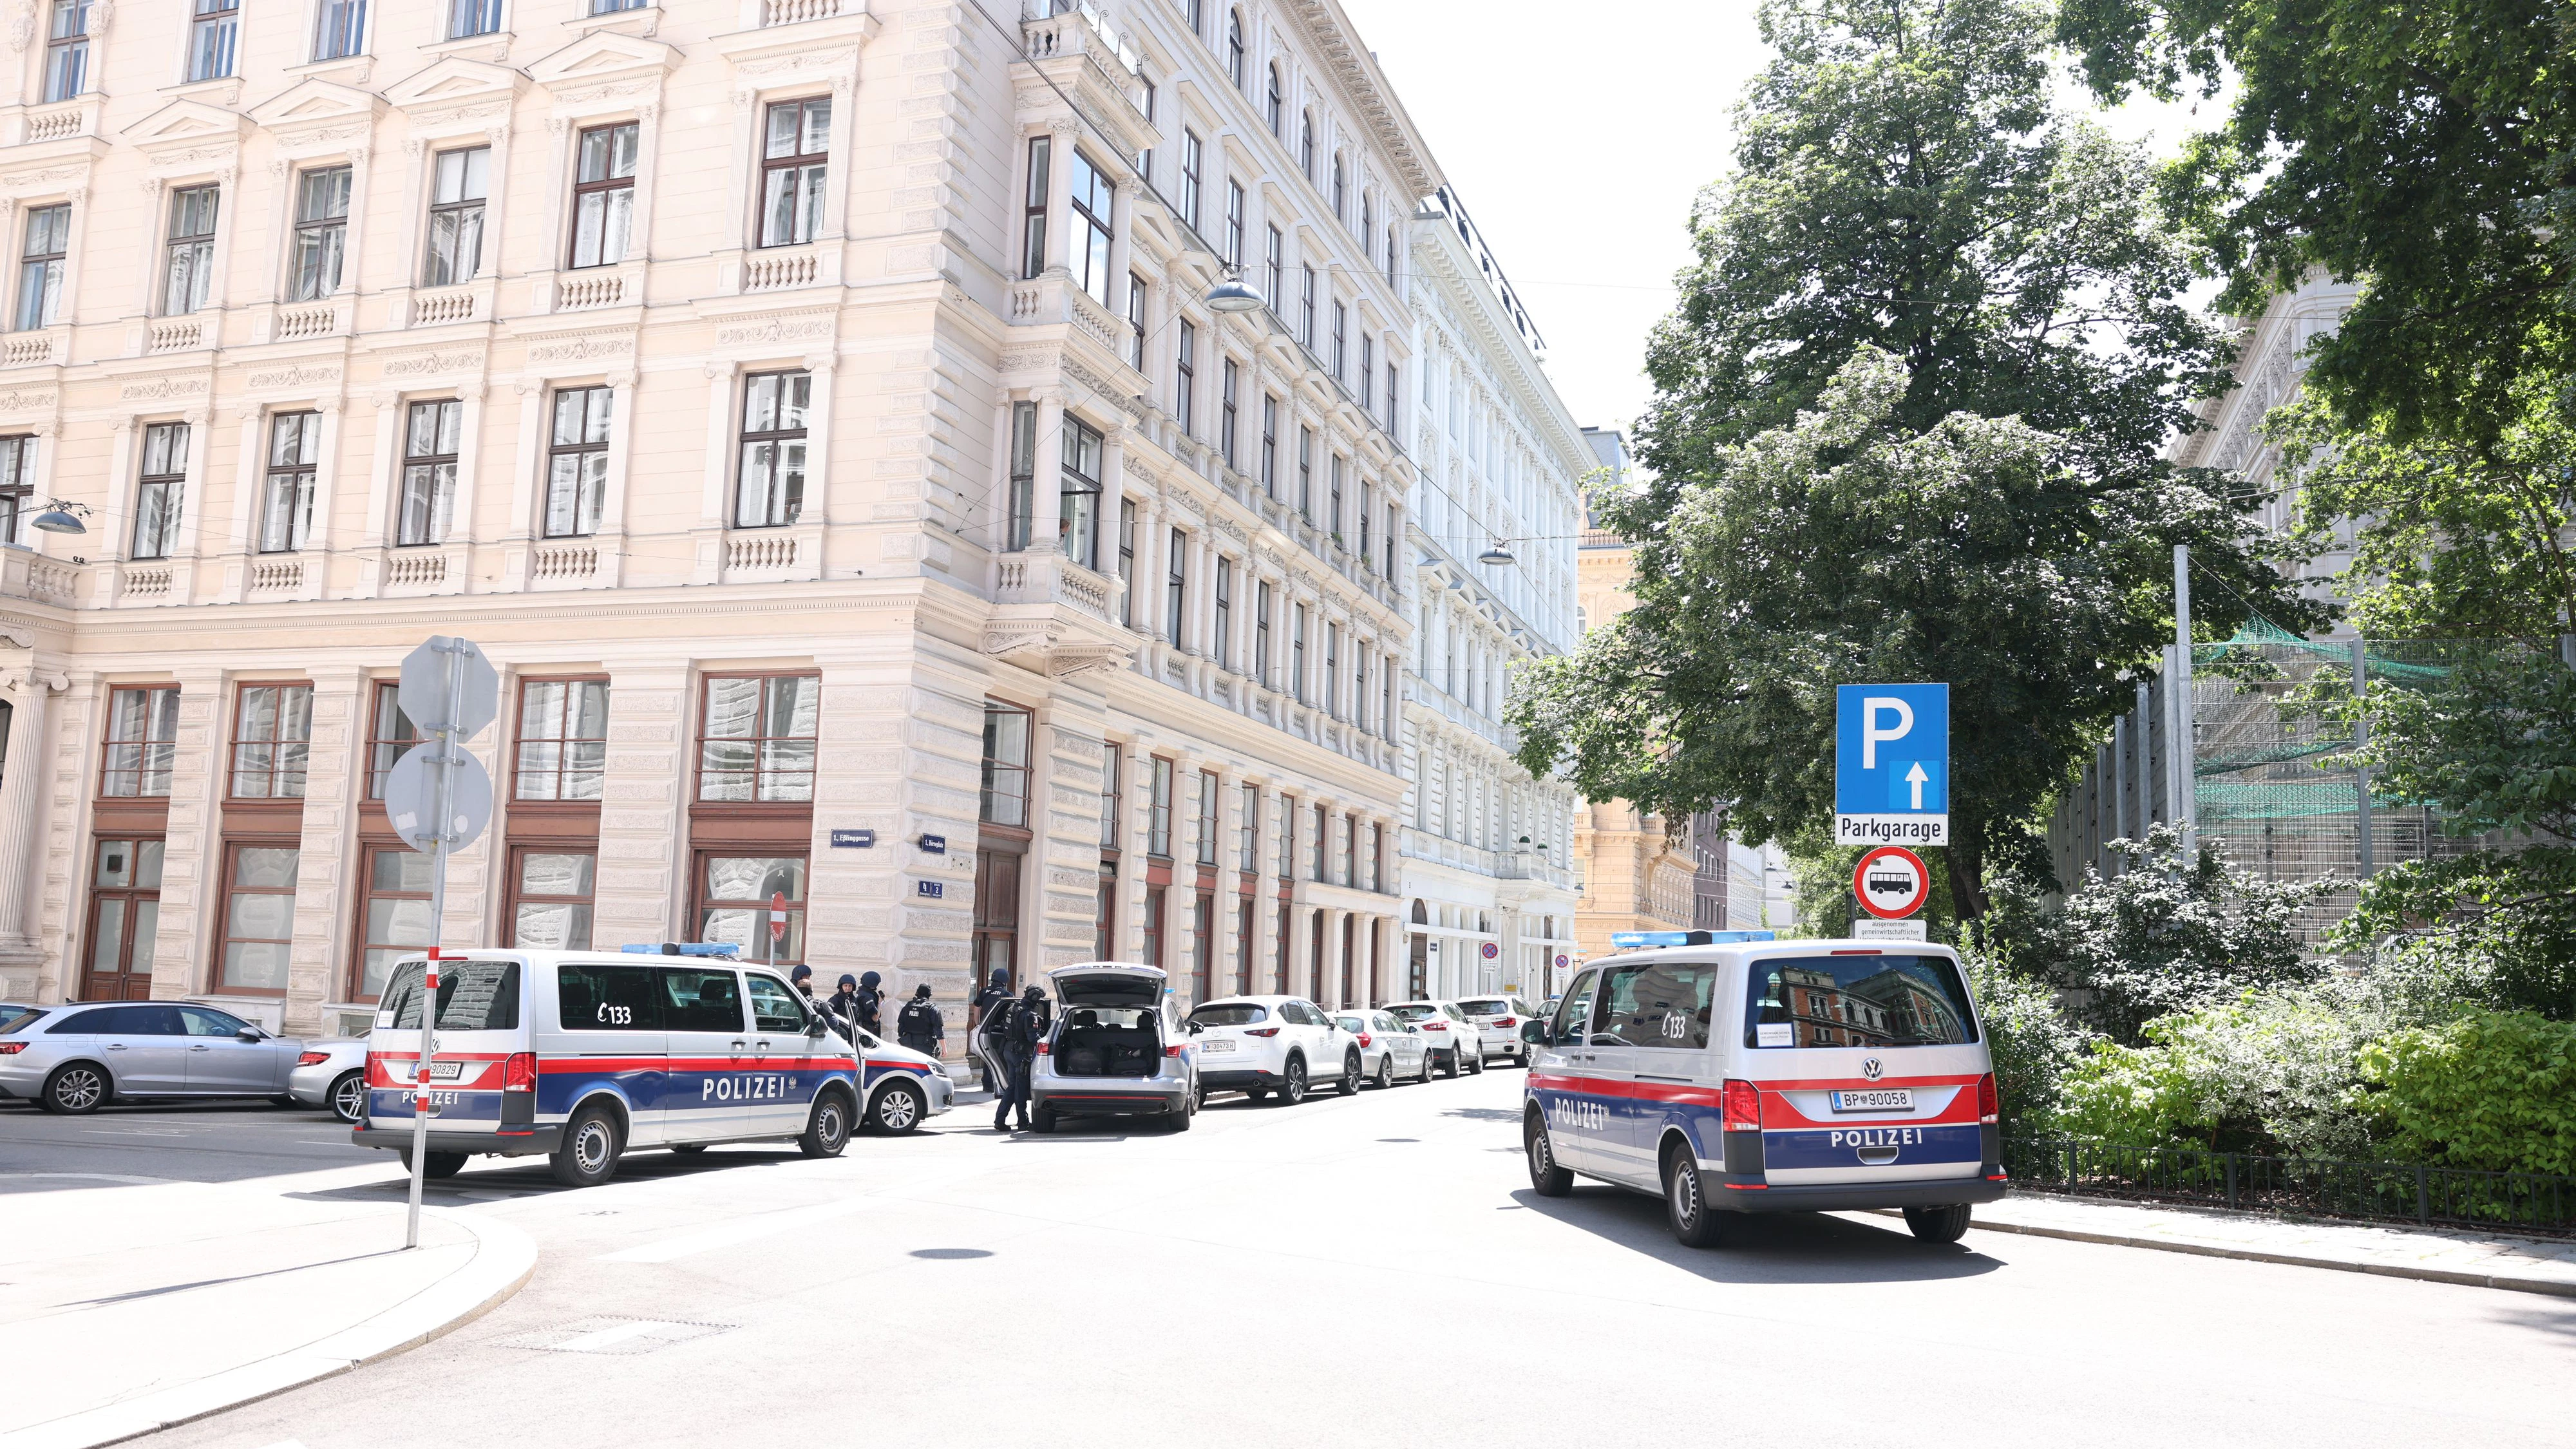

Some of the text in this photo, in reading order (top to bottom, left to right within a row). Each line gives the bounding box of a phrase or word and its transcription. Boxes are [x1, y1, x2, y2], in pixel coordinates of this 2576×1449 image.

[1863, 697, 1914, 770] P
[839, 834, 869, 842] Eßlinggasse
[1842, 818, 1941, 842] Parkgarage
[923, 882, 927, 891] 4
[608, 1006, 632, 1024] 133
[1670, 1016, 1686, 1039] 133
[431, 1065, 457, 1075] 90829
[402, 1091, 459, 1104] POIZEI
[702, 1076, 784, 1101] POLIZEI
[1844, 1092, 1908, 1106] BP 90058
[1555, 1097, 1603, 1131] POLIZEI
[1831, 1128, 1922, 1147] POLIZEI
